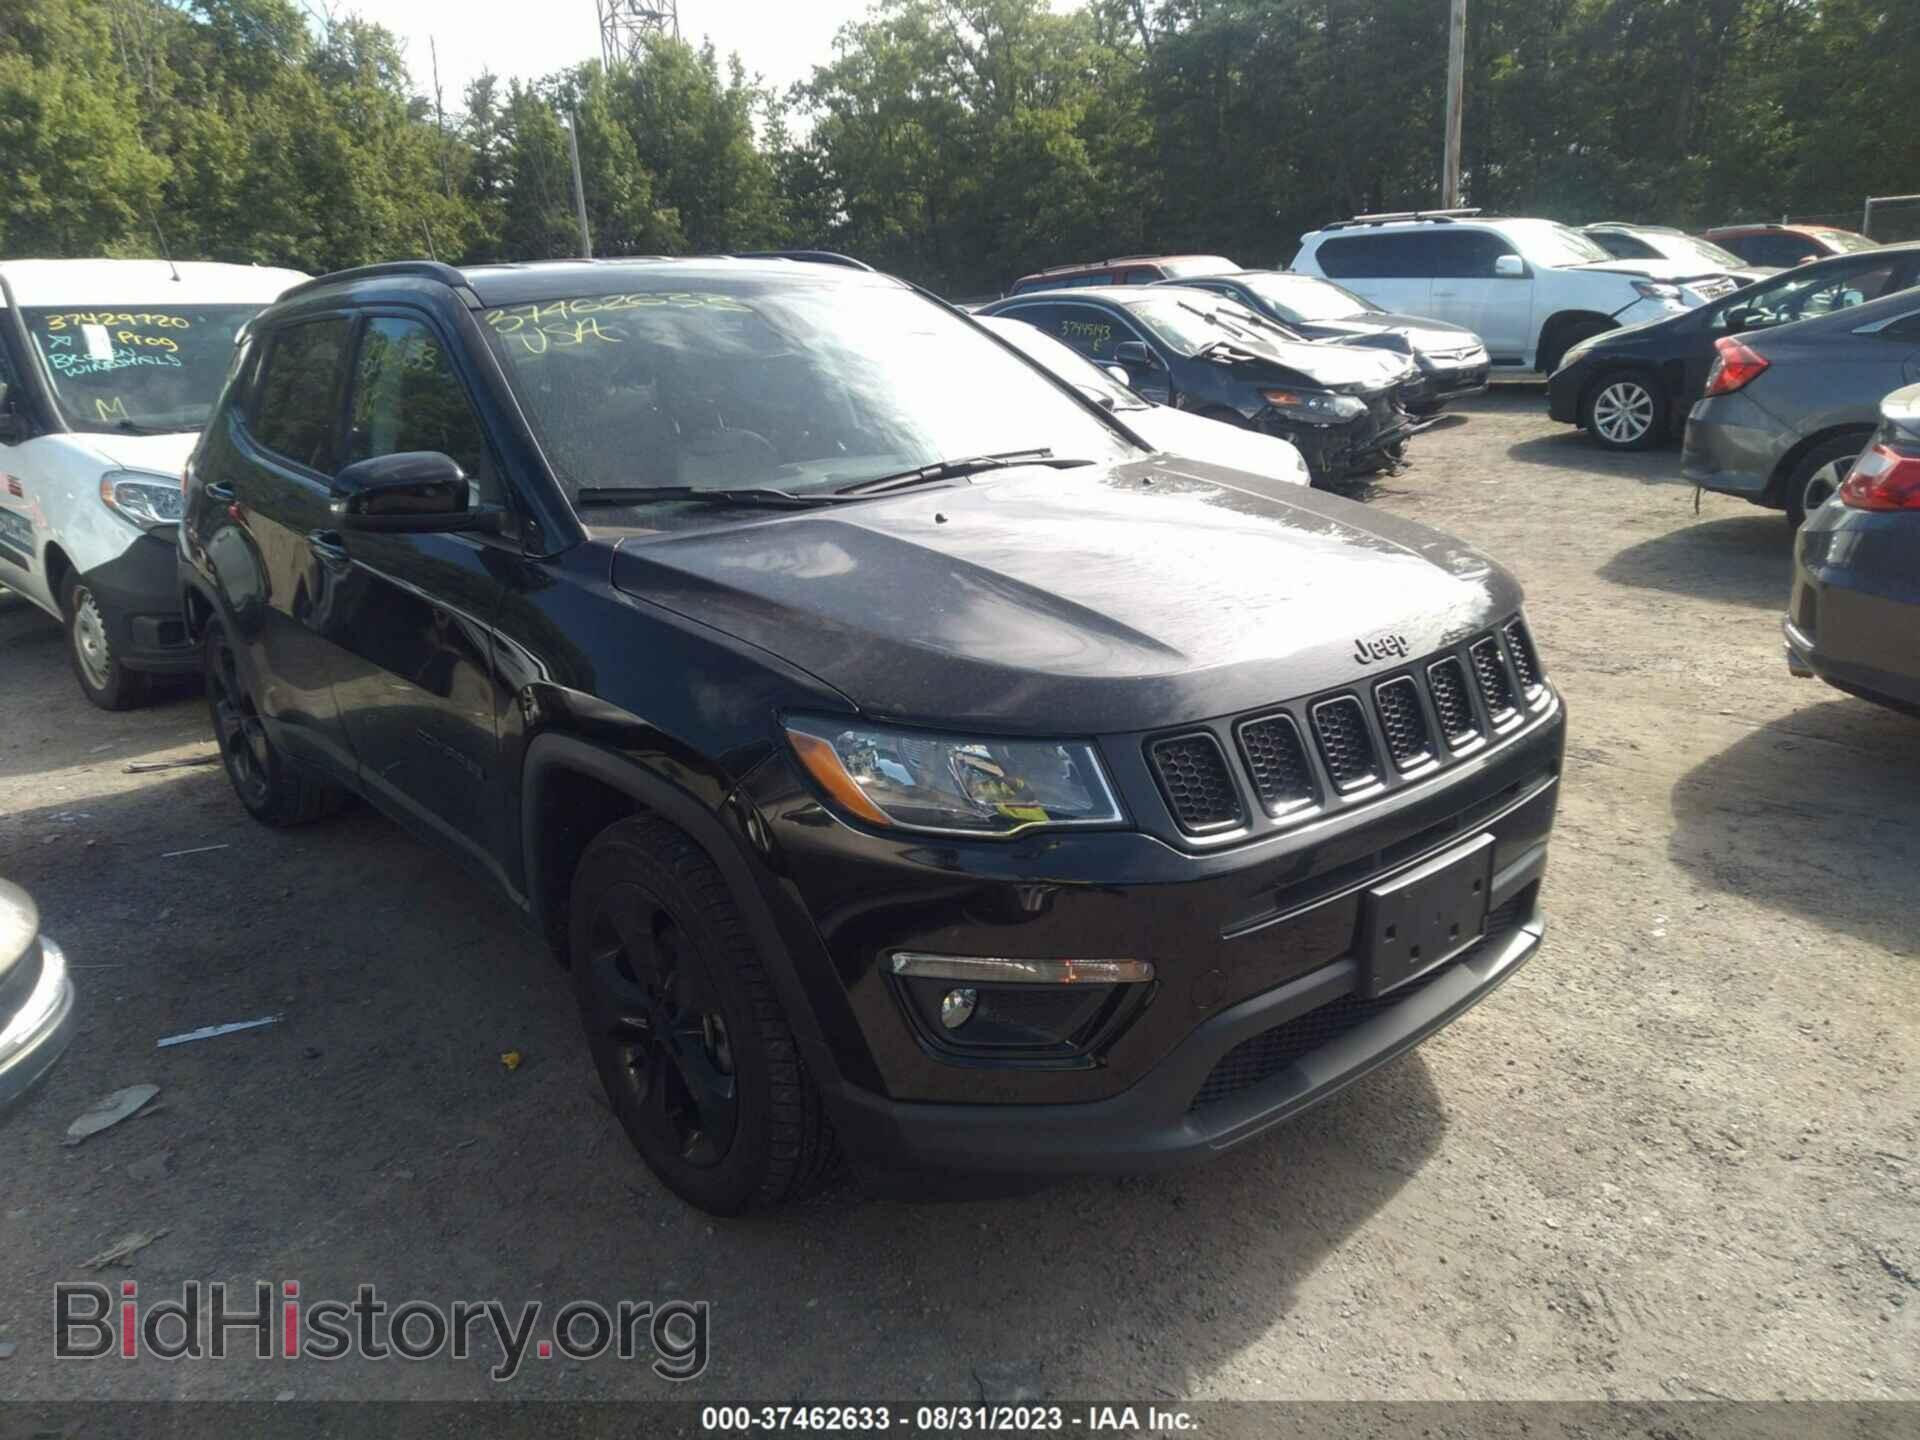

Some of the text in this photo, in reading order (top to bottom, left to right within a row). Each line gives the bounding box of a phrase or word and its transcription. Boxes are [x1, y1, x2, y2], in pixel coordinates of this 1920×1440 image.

[45, 311, 191, 331] 37429720
[520, 316, 625, 354] USA
[95, 396, 130, 422] M
[1353, 634, 1410, 665] Jeep
